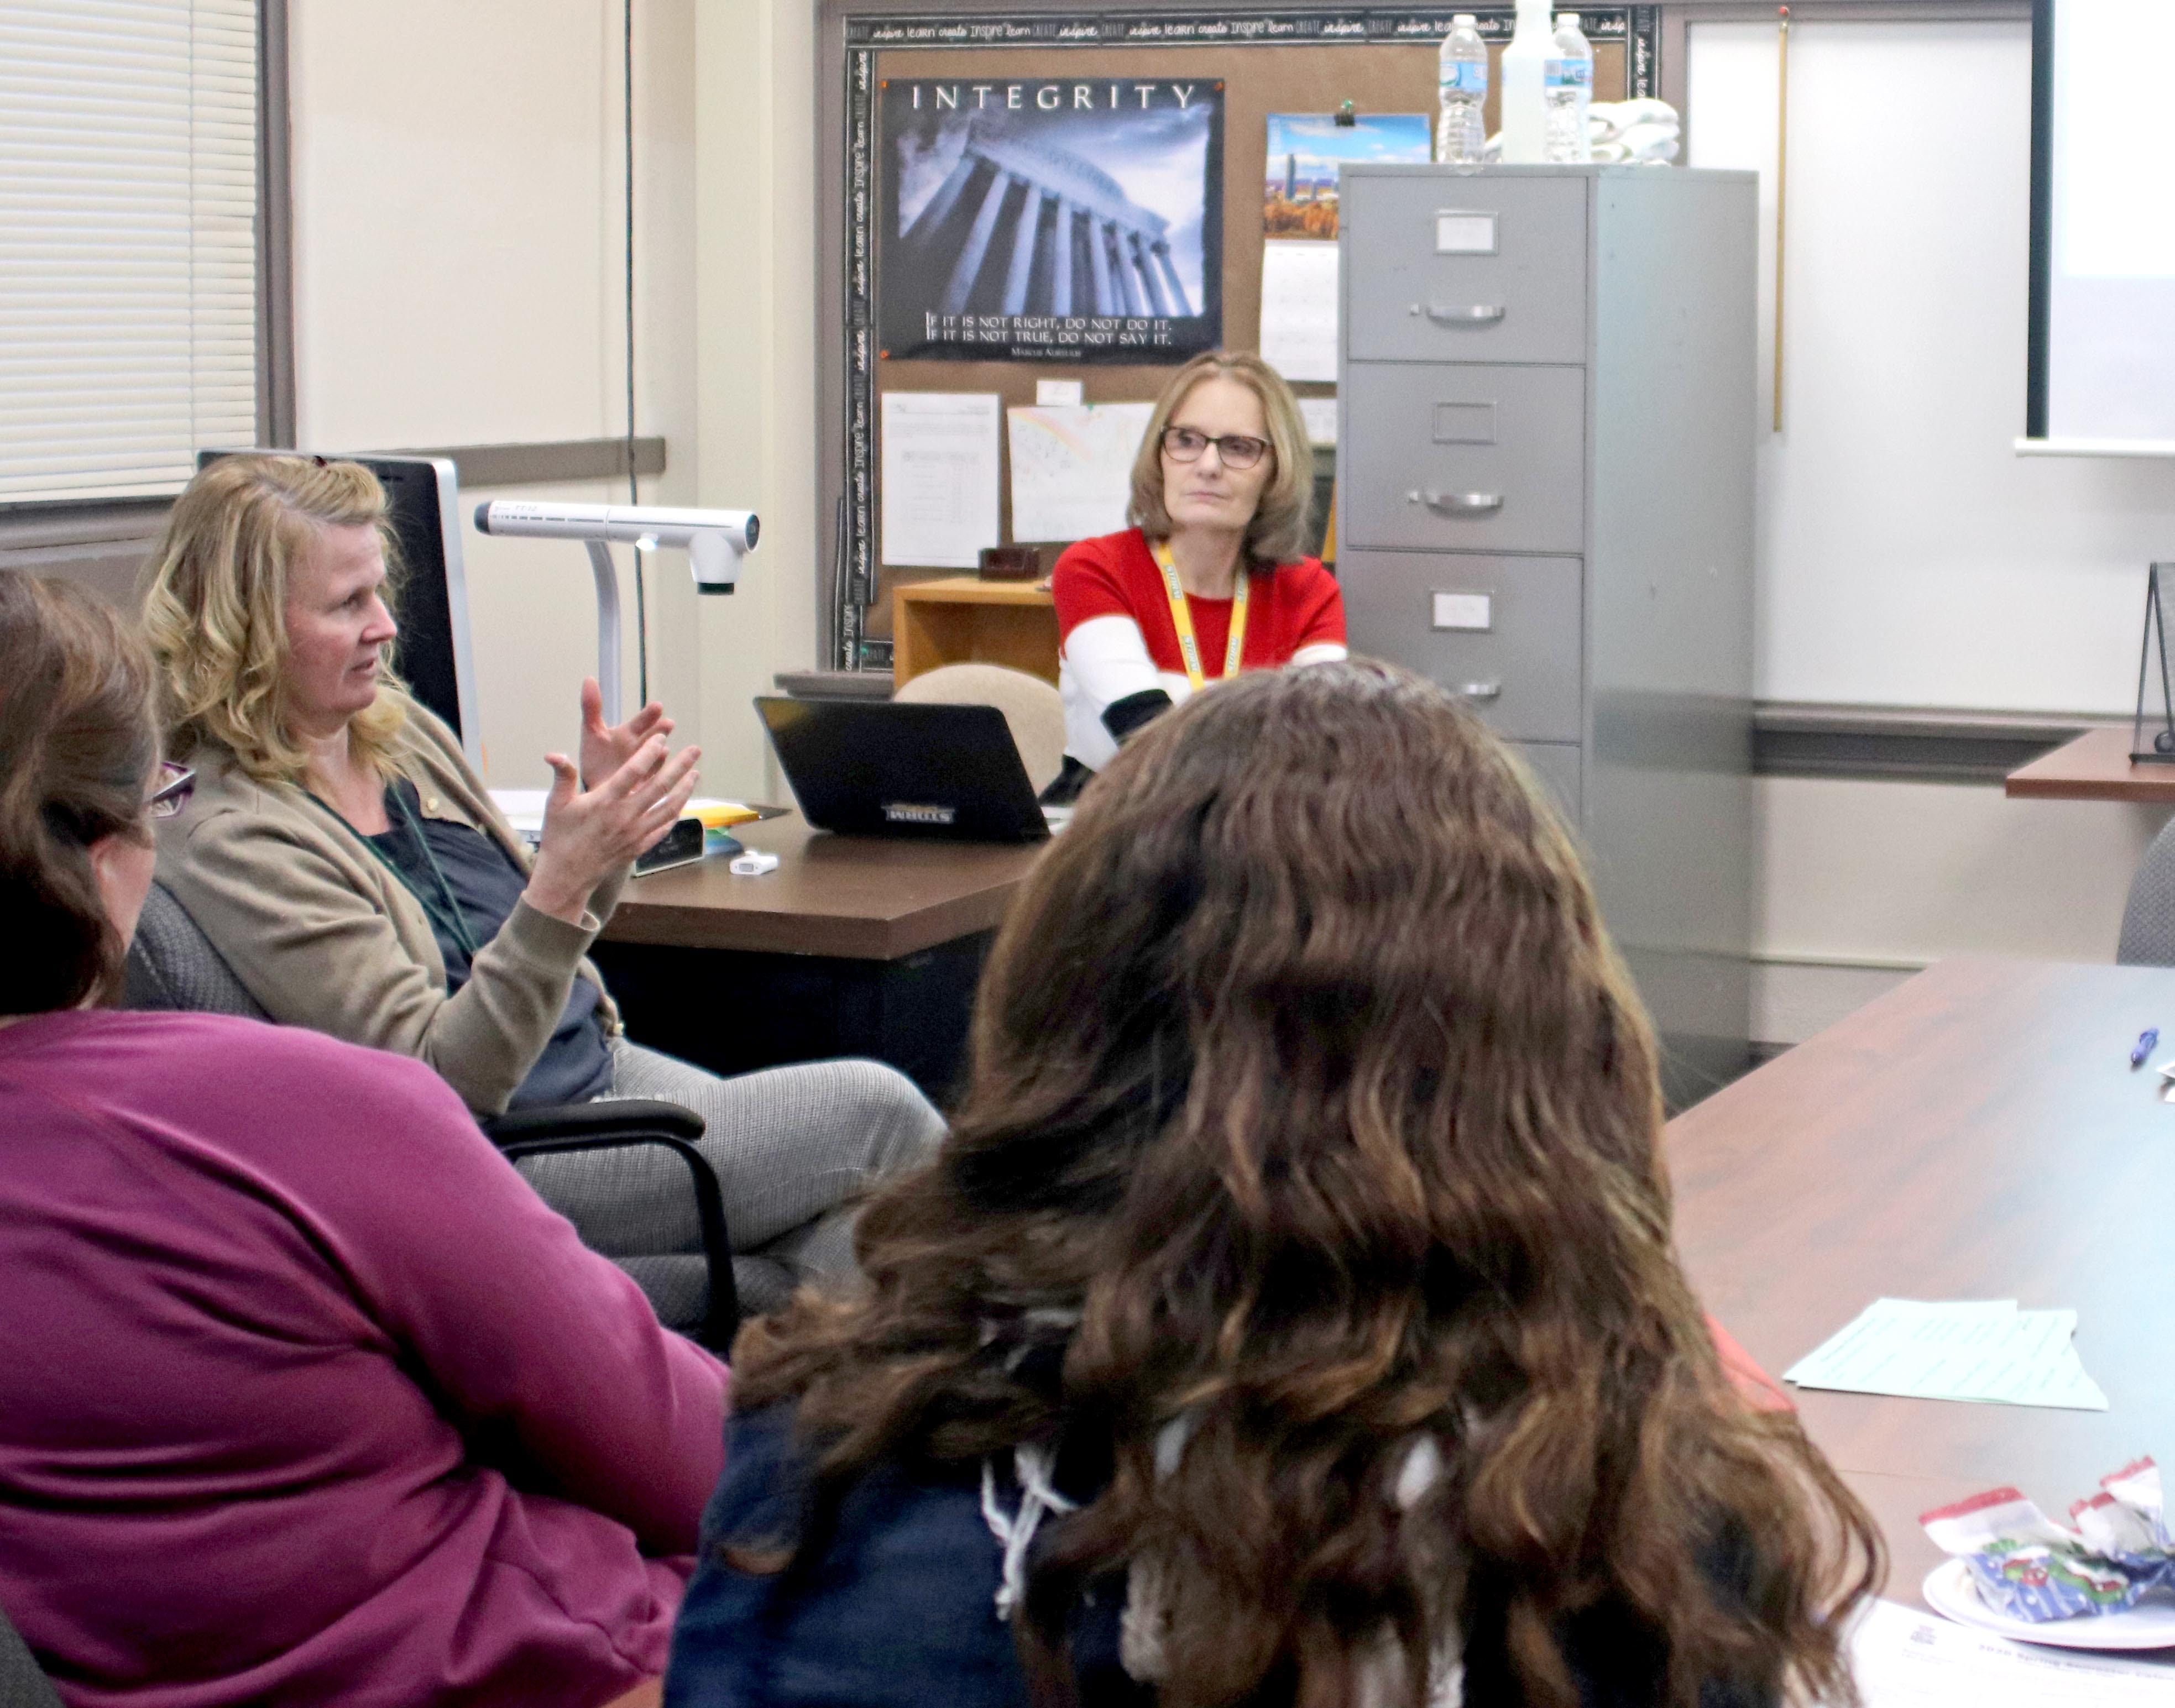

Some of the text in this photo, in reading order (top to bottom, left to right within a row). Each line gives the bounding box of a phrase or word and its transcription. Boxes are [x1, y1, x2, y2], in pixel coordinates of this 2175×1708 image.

[1268, 19, 1294, 33] learn
[1324, 20, 1364, 35] inspire
[912, 85, 1193, 109] INTEGRITY
[925, 312, 1172, 331] IF IT IS NOT RIGHT, DO NOT DO IT.
[926, 326, 1172, 345] IF IT IS NOT TRUE, DO NOT SAY IT.
[890, 810, 950, 822] STORM
